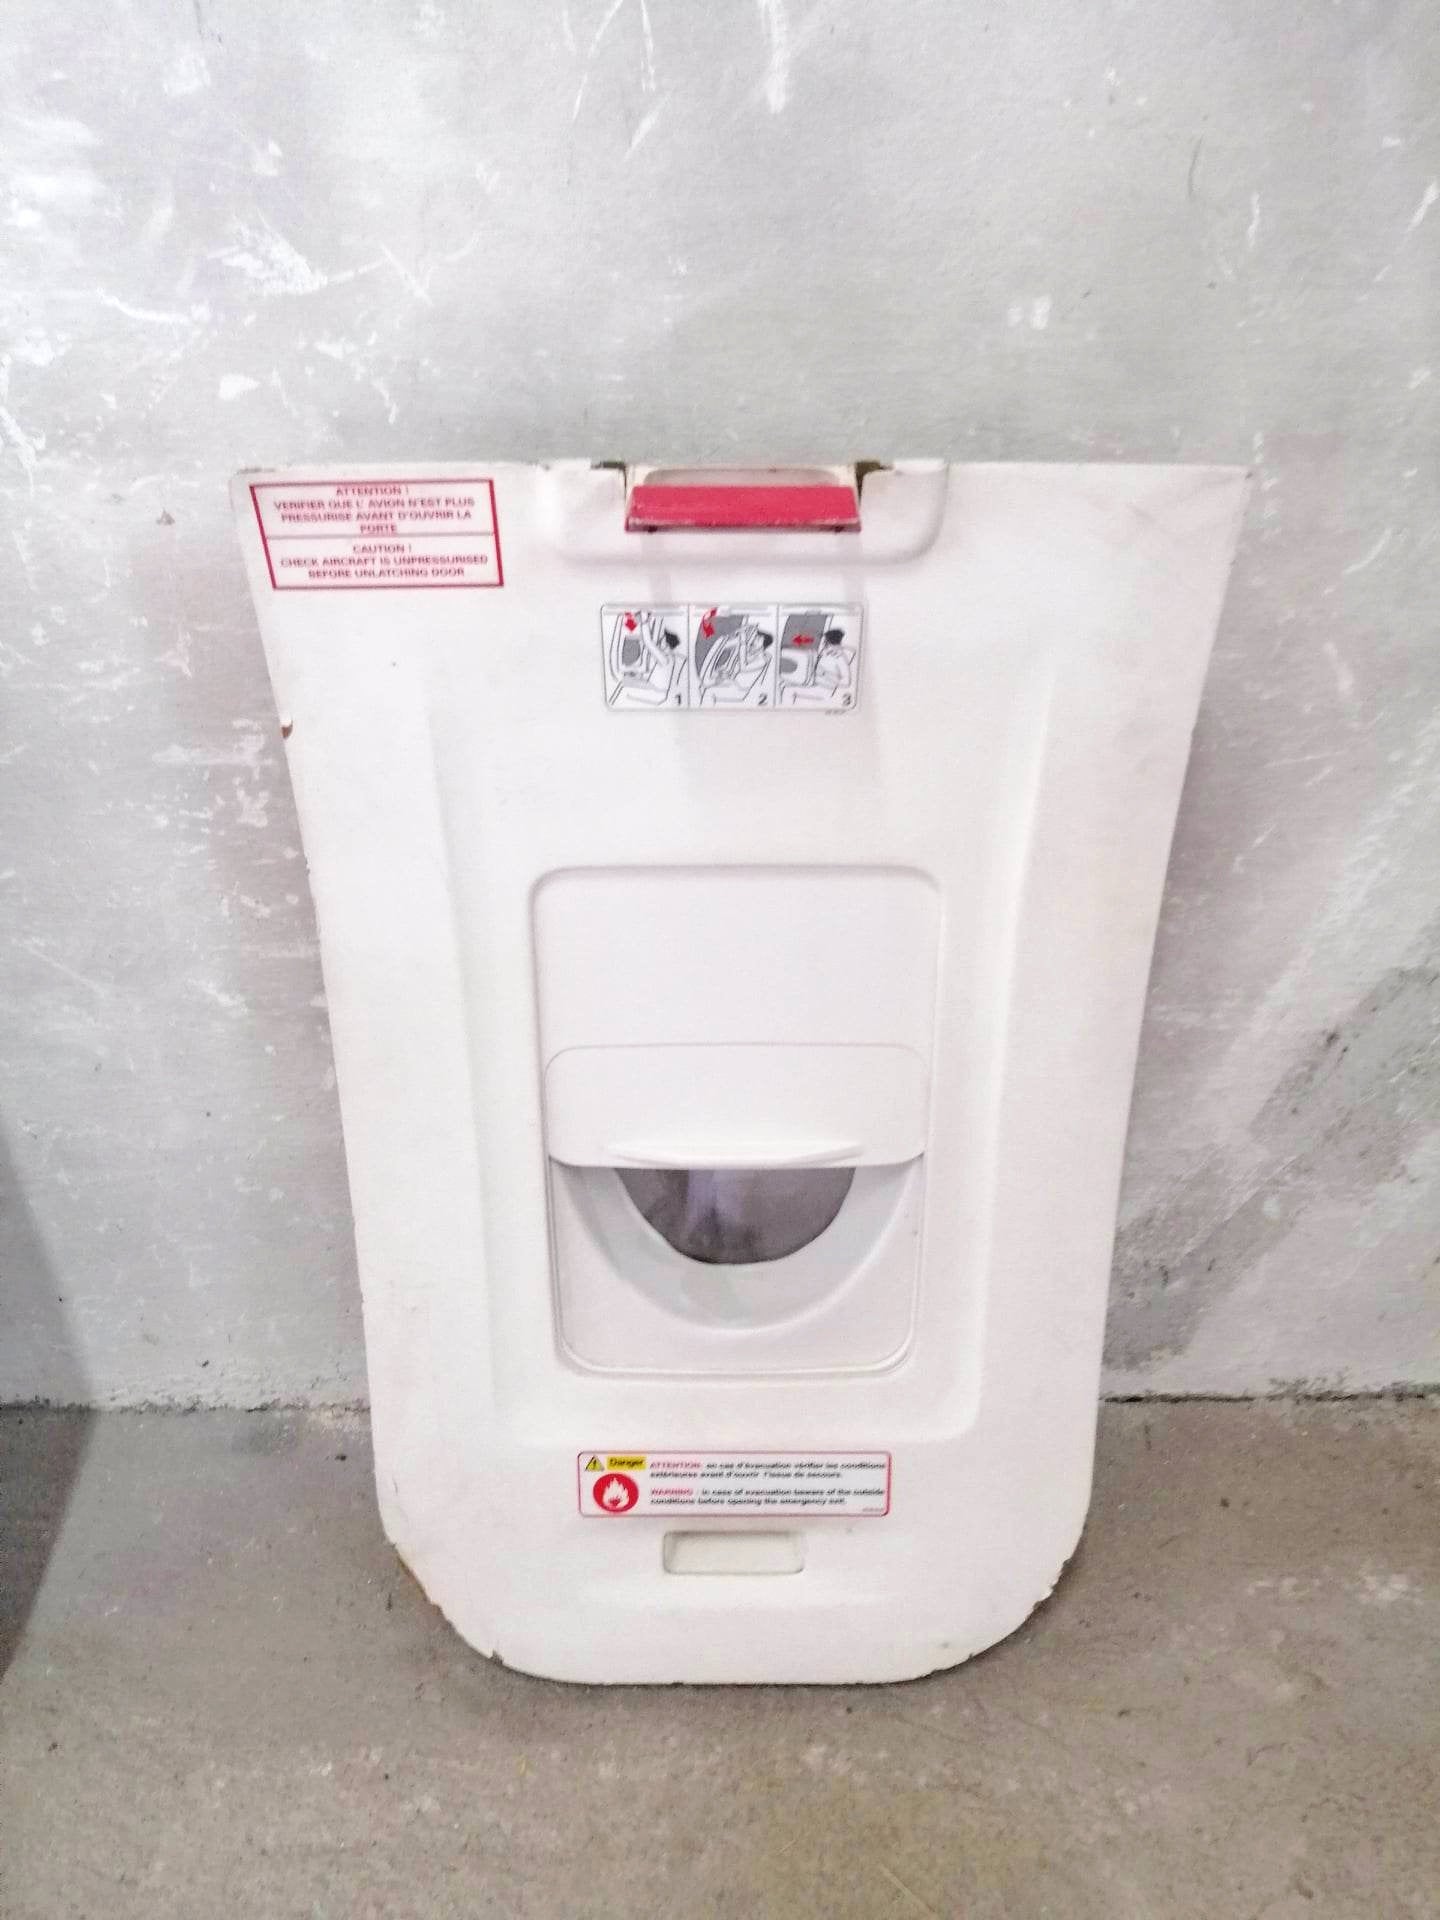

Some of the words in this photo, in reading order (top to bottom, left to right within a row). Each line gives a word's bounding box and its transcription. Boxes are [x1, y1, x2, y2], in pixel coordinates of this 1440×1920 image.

[336, 486, 402, 496] ATTENTION
[274, 500, 325, 510] VERIFIER
[328, 500, 353, 510] QUE
[368, 499, 405, 508] AVION
[408, 498, 441, 508] N'EST
[444, 497, 476, 507] PLUS
[281, 512, 352, 522] PRESSURISE
[356, 511, 394, 521] AVANT
[398, 510, 454, 520] D'OUVRIR
[457, 510, 472, 519] LA
[360, 523, 398, 534] PORTE
[353, 544, 405, 554] CAUTION
[280, 557, 319, 568] CHECK
[322, 556, 376, 567] AIRCRAFT
[380, 556, 390, 565] IS
[393, 554, 488, 565] UNPRESSURISED
[308, 569, 351, 578] BEFORE
[355, 568, 428, 578] UNLATCHING
[431, 567, 465, 577] DOOR
[674, 694, 681, 704] 1
[757, 694, 768, 705] 2
[842, 693, 852, 705] 3
[609, 1455, 645, 1470] Danger
